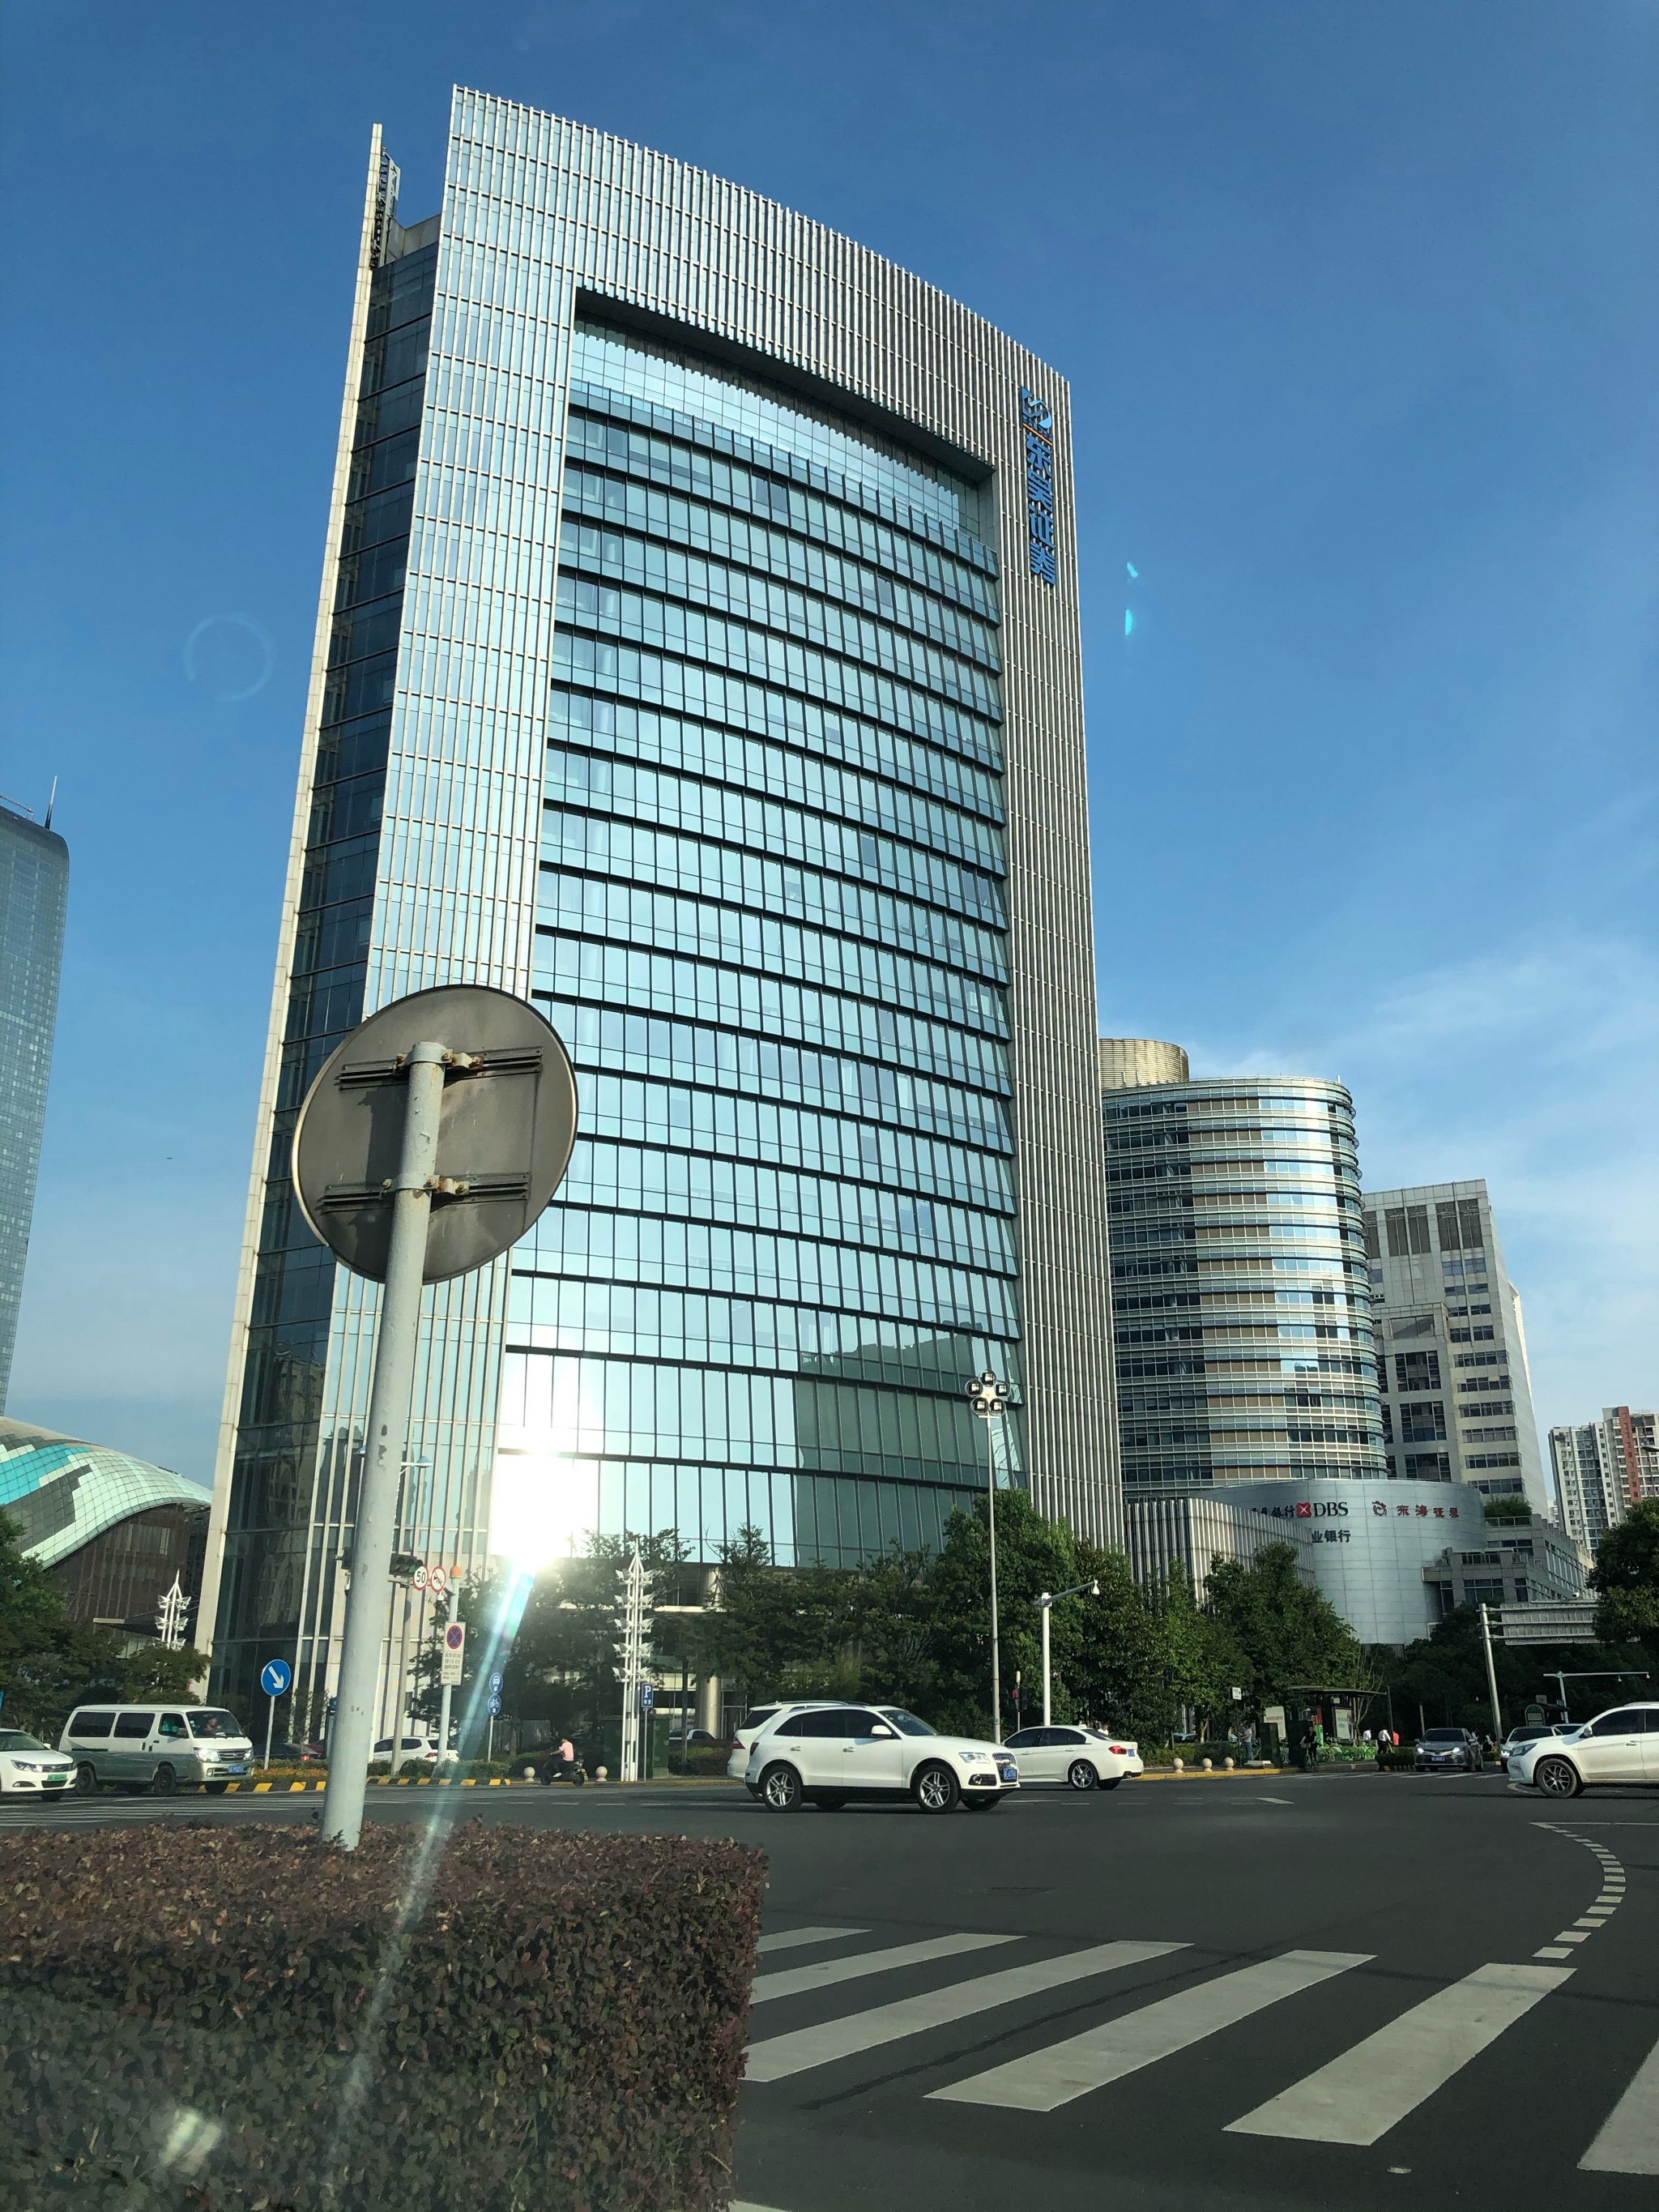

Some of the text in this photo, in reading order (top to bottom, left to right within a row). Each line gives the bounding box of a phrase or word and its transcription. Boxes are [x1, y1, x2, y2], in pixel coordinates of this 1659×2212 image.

[1026, 432, 1056, 585] 东吴证券
[1313, 1501, 1349, 1517] DBS
[1396, 1505, 1459, 1518] 东海证券
[416, 1570, 426, 1584] 50
[644, 1685, 651, 1698] P
